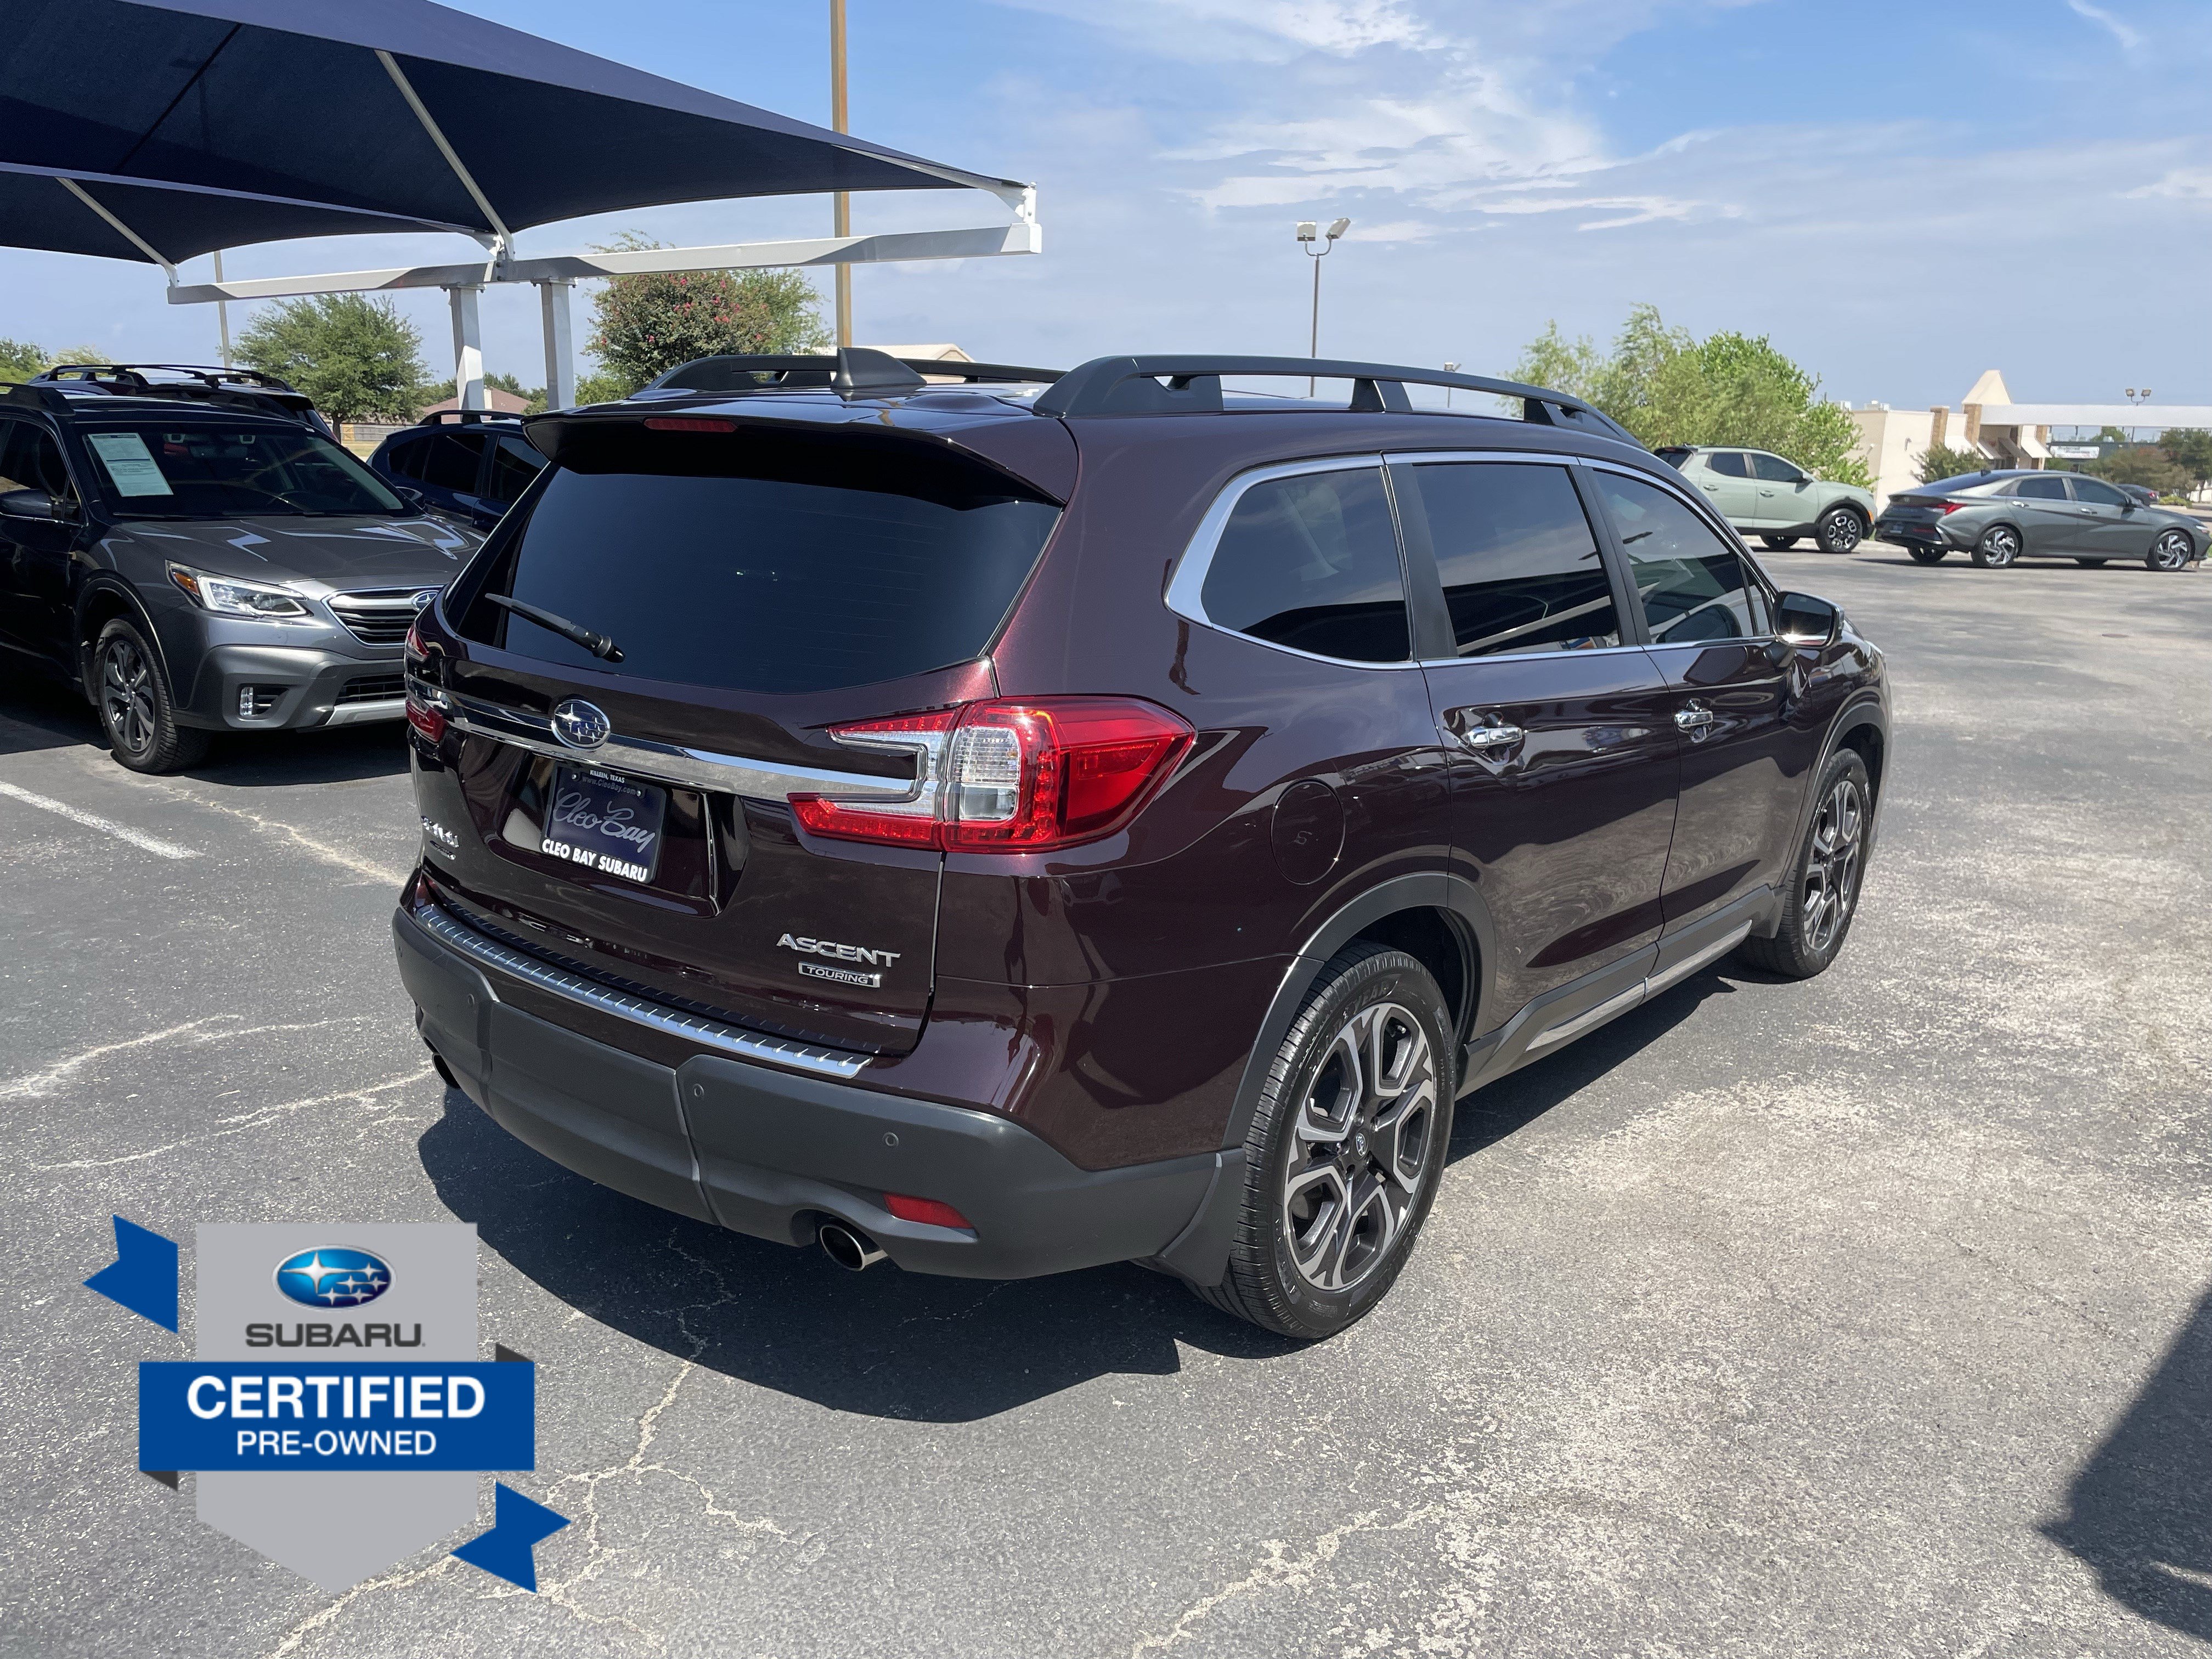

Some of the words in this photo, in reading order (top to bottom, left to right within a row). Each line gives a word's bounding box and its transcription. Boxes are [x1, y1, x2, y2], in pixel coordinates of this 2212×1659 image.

[582, 776, 636, 795] www.CleoBay.com
[590, 769, 609, 780] KILLEEN,
[610, 774, 625, 783] TEXAS
[552, 787, 602, 830] Cleo
[600, 800, 656, 853] Bay
[542, 839, 570, 859] CLEO
[572, 848, 597, 866] BAY
[597, 855, 648, 882] SUBARU
[776, 933, 901, 968] ASCENT
[806, 966, 868, 984] TOURING
